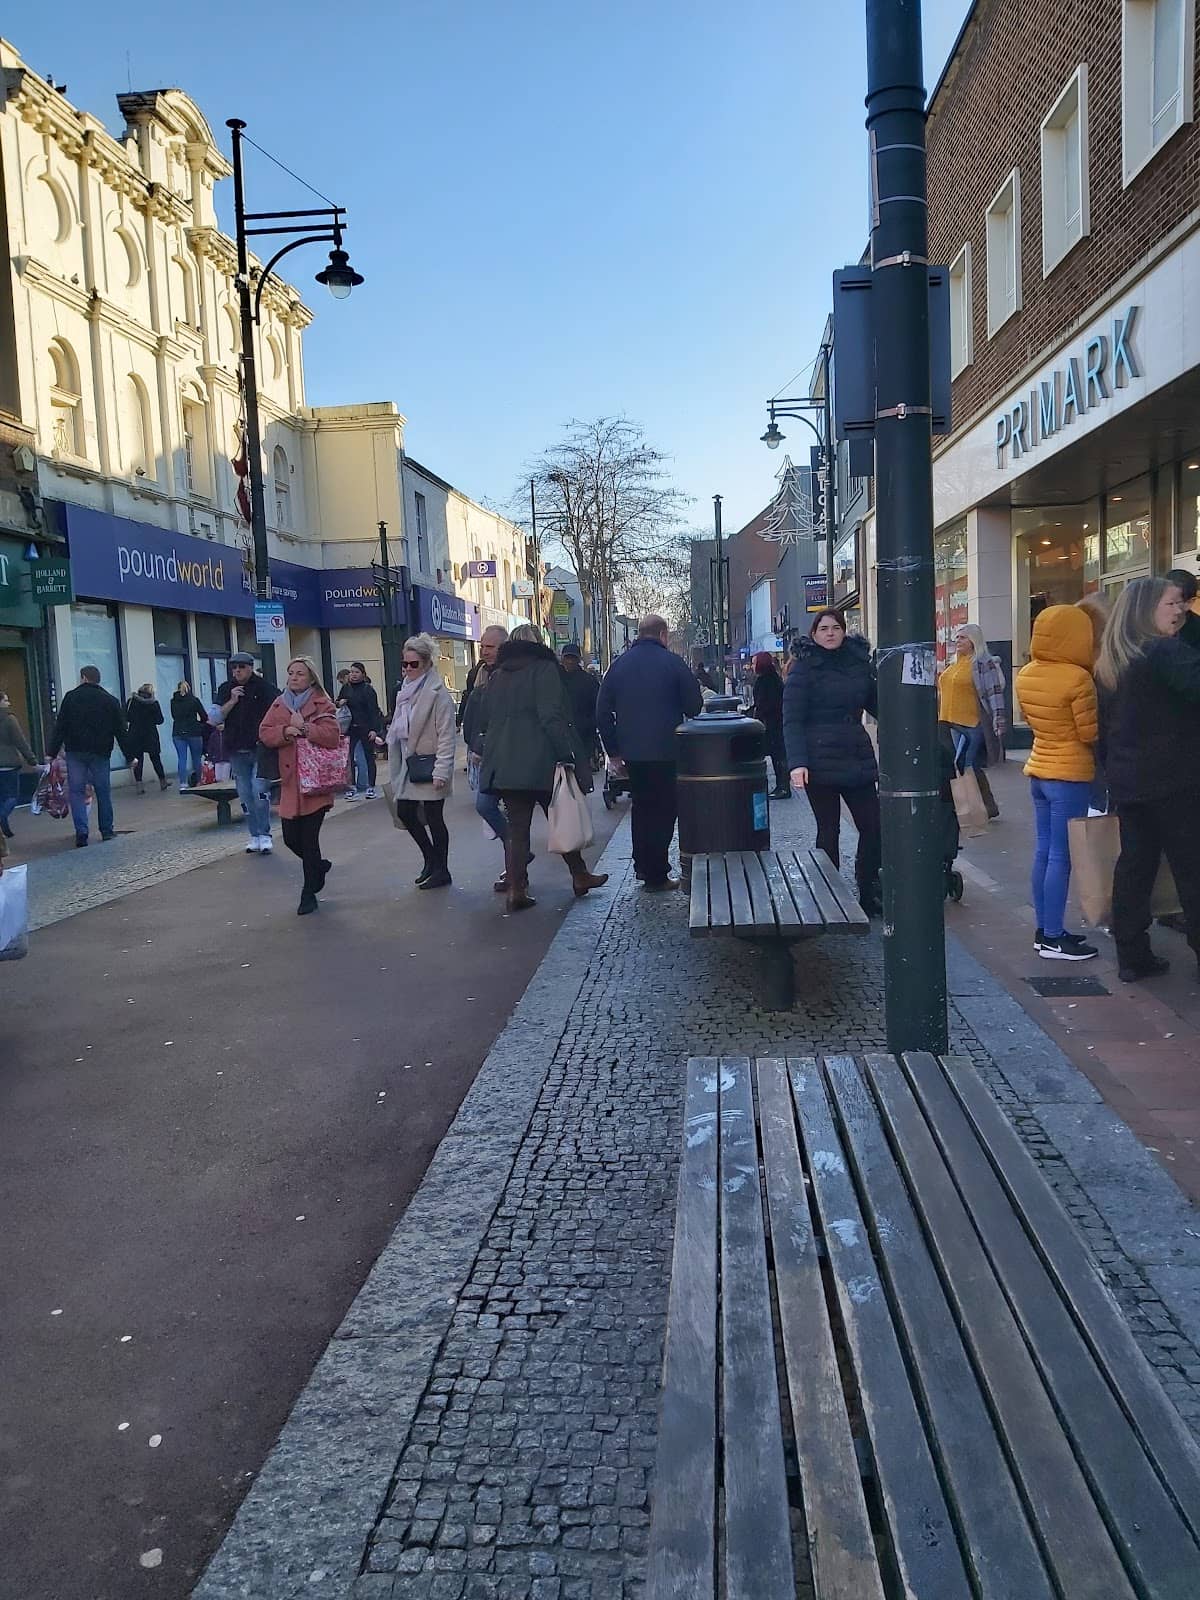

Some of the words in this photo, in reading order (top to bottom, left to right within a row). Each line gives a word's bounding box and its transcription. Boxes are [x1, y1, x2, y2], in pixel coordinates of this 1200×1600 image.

[996, 305, 1142, 469] PRIMARK
[35, 568, 67, 579] HOLLAND
[117, 545, 225, 591] poundworld
[47, 577, 55, 585] &
[36, 584, 67, 594] BARRETT
[324, 585, 394, 601] poundwo
